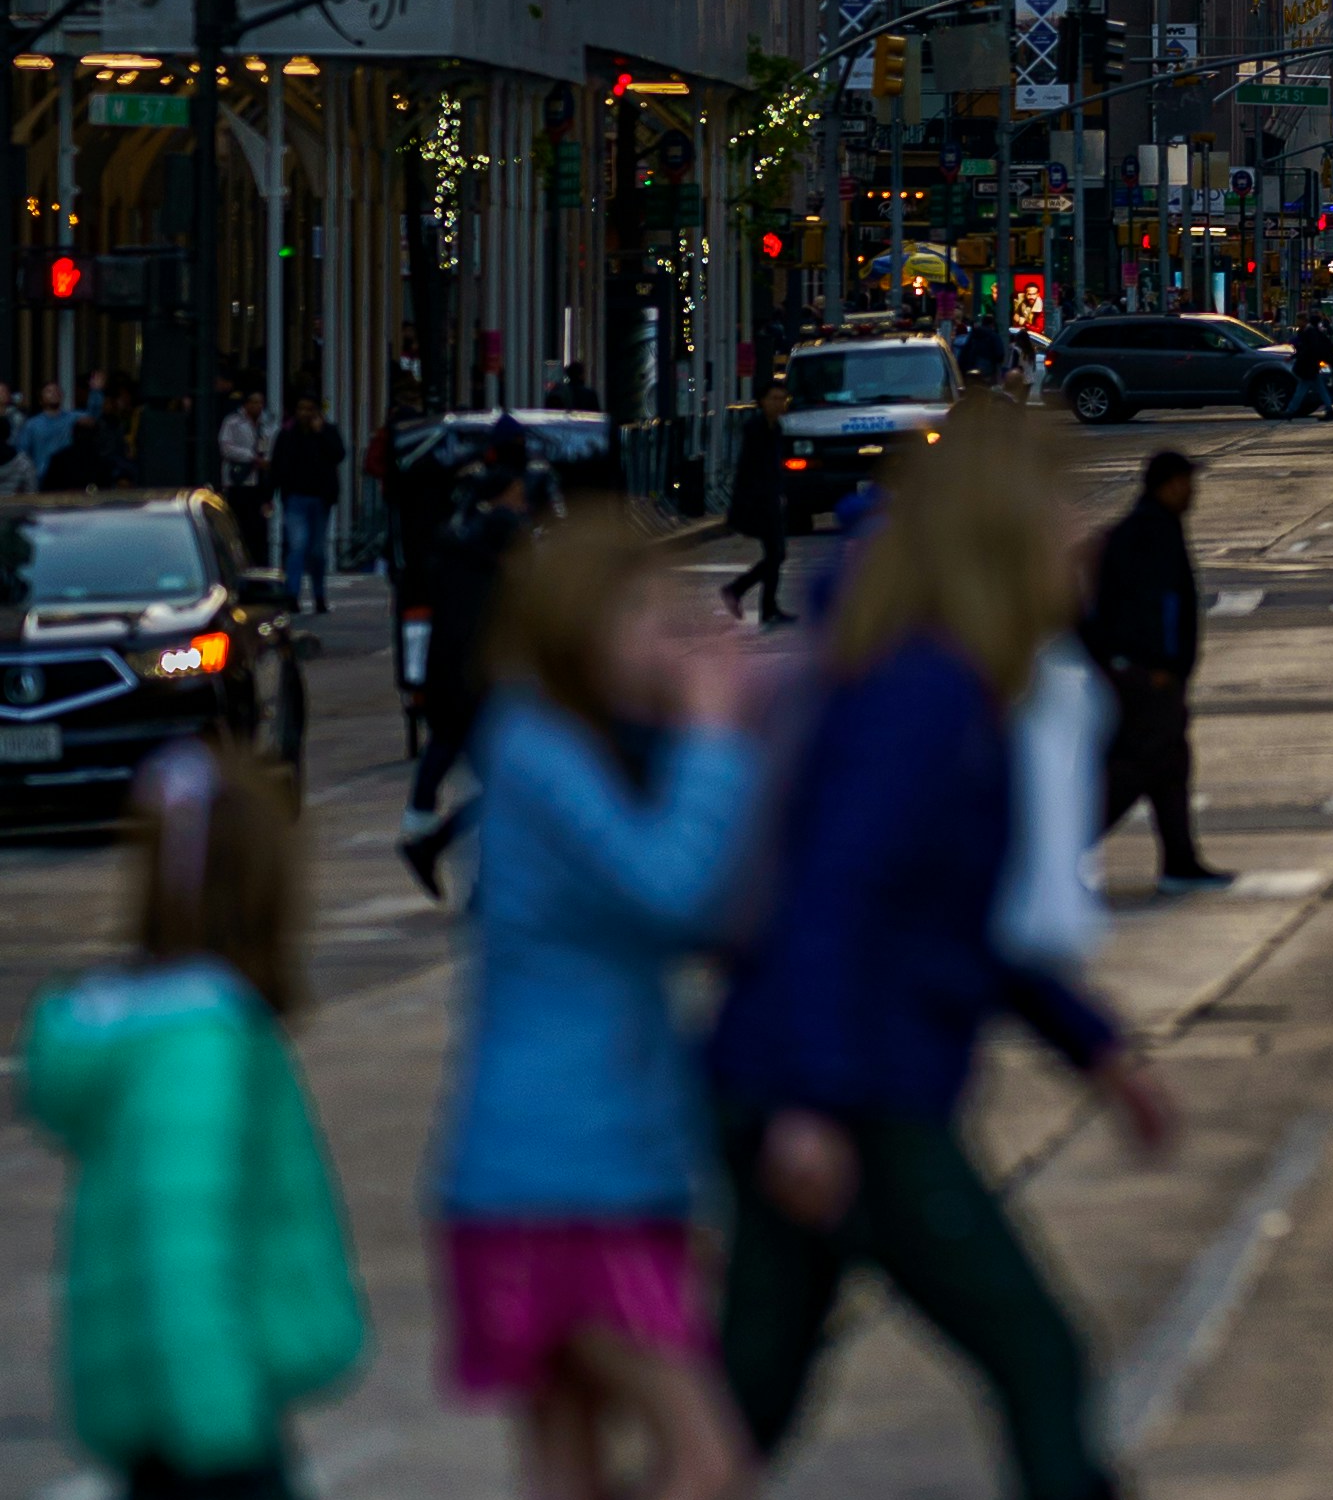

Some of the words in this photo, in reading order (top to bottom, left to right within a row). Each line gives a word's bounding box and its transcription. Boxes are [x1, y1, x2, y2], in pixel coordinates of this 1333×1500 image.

[1261, 88, 1271, 101] W
[1273, 88, 1289, 102] 54
[1292, 88, 1305, 102] St
